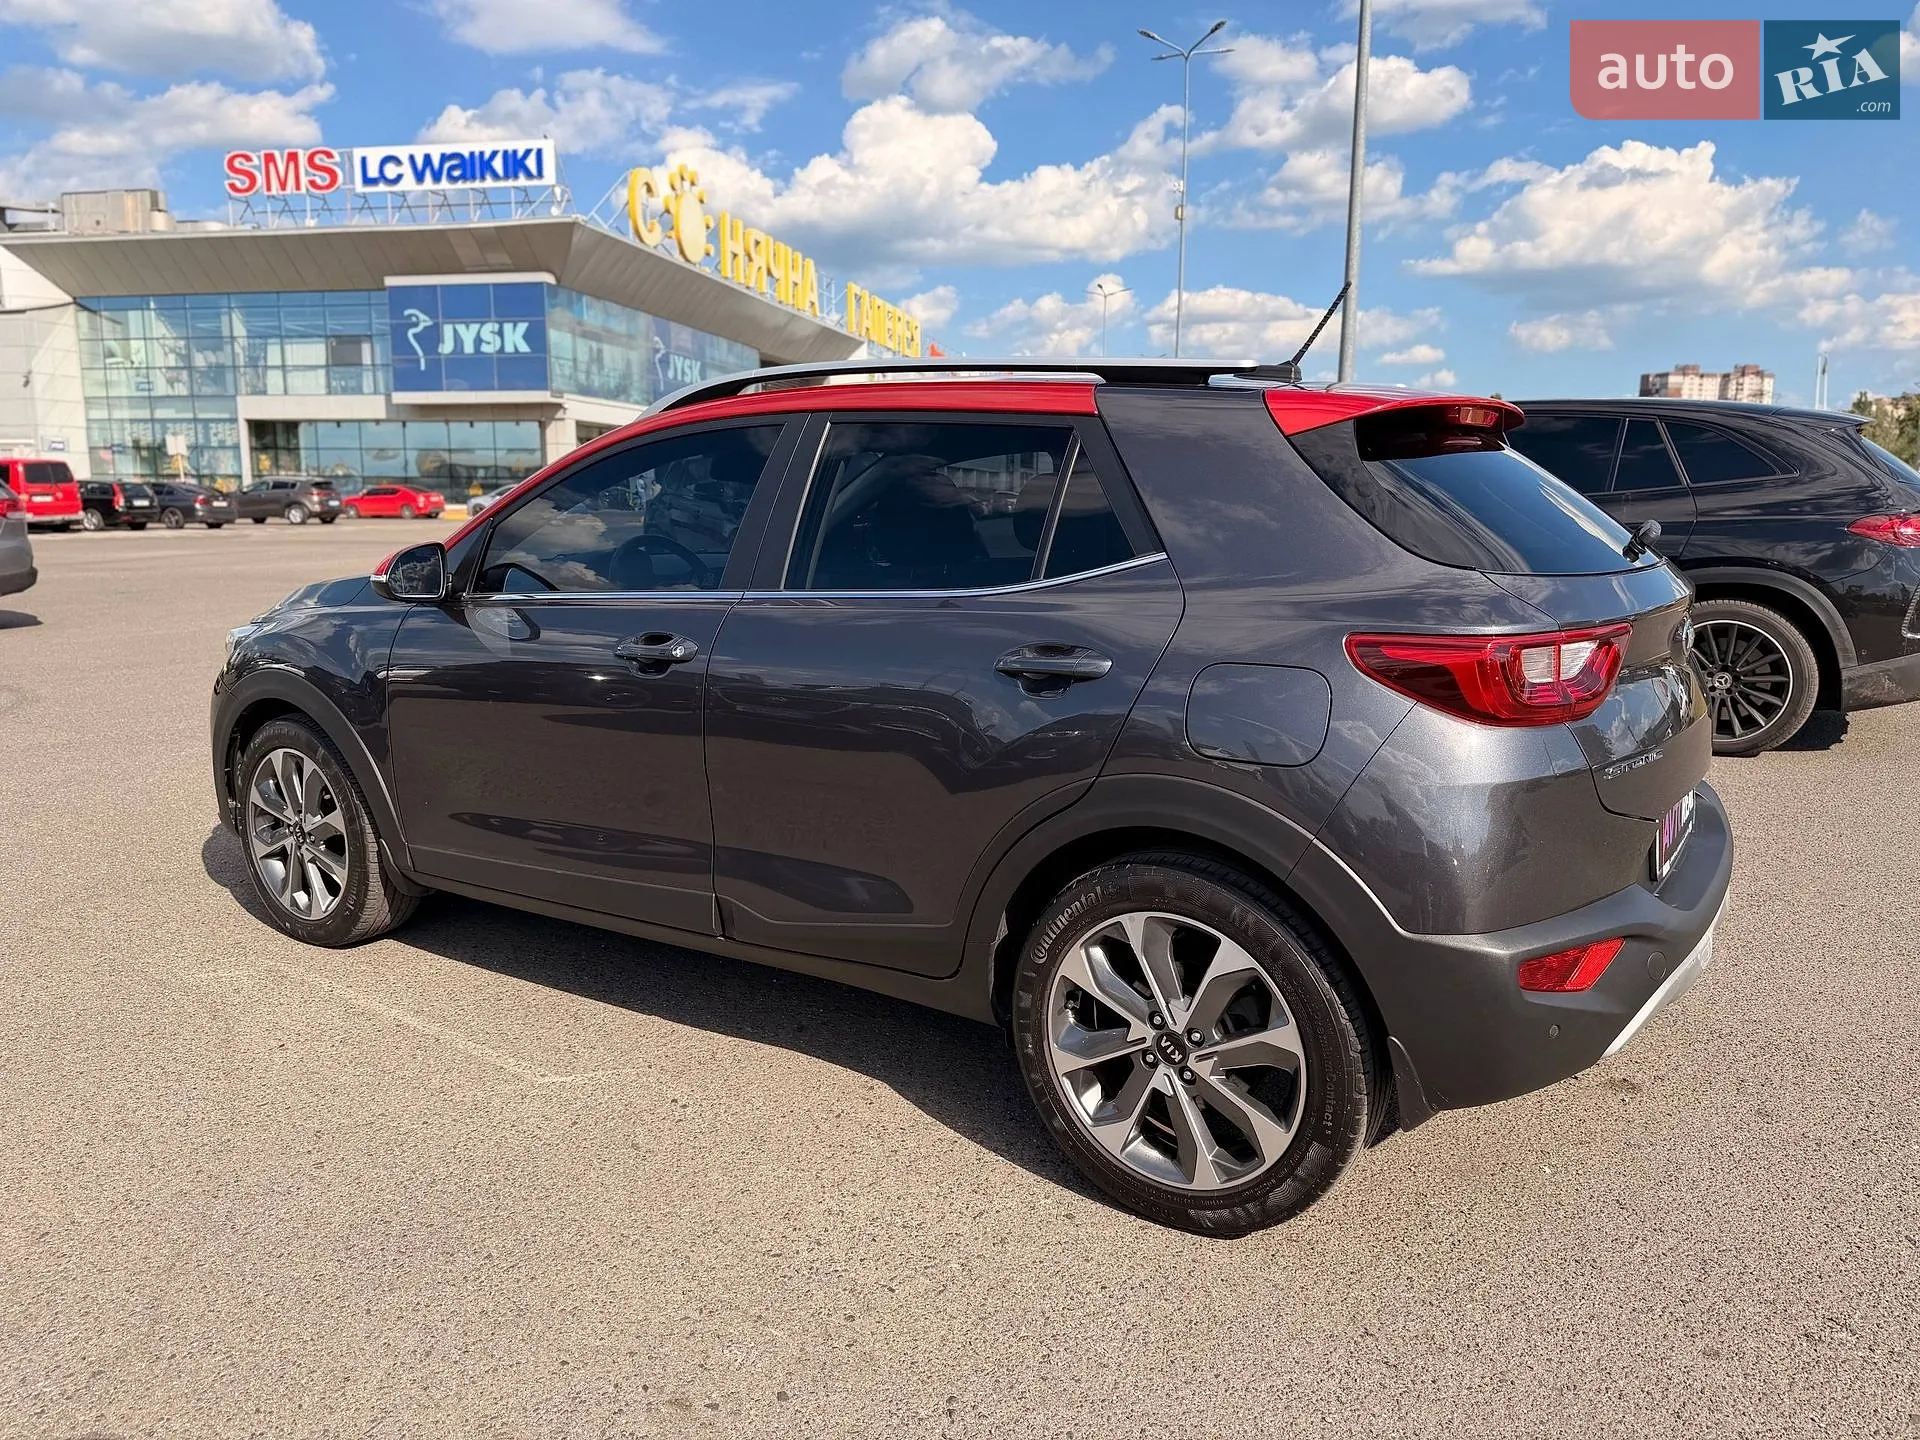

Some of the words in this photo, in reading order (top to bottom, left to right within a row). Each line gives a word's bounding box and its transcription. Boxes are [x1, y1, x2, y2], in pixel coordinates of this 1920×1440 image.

[225, 148, 341, 195] SMS
[361, 153, 404, 187] LC
[438, 322, 532, 354] JYSK
[668, 353, 701, 384] JYSK
[1030, 885, 1102, 964] Continental
[1160, 1035, 1183, 1063] KIA
